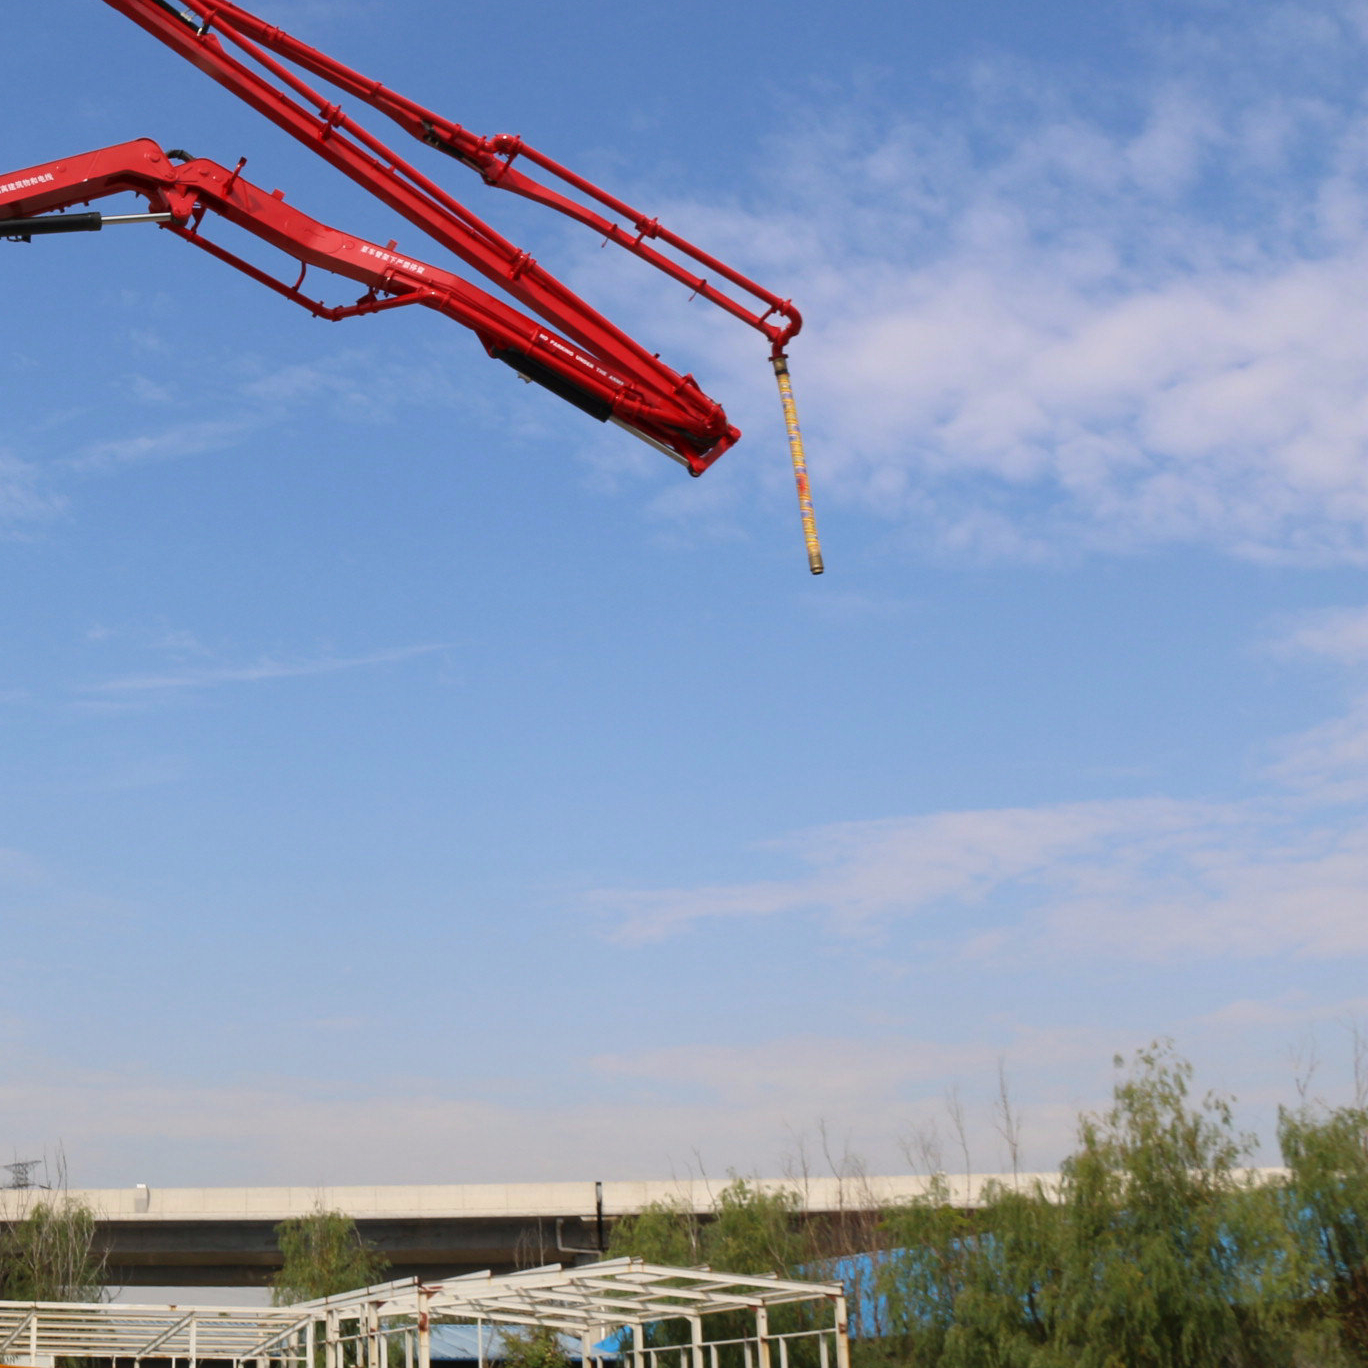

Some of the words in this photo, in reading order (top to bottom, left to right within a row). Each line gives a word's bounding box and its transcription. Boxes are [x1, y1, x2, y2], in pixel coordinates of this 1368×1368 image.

[539, 333, 549, 341] NO
[550, 340, 574, 357] PARKING
[576, 355, 594, 369] UNDER
[597, 367, 607, 376] THE
